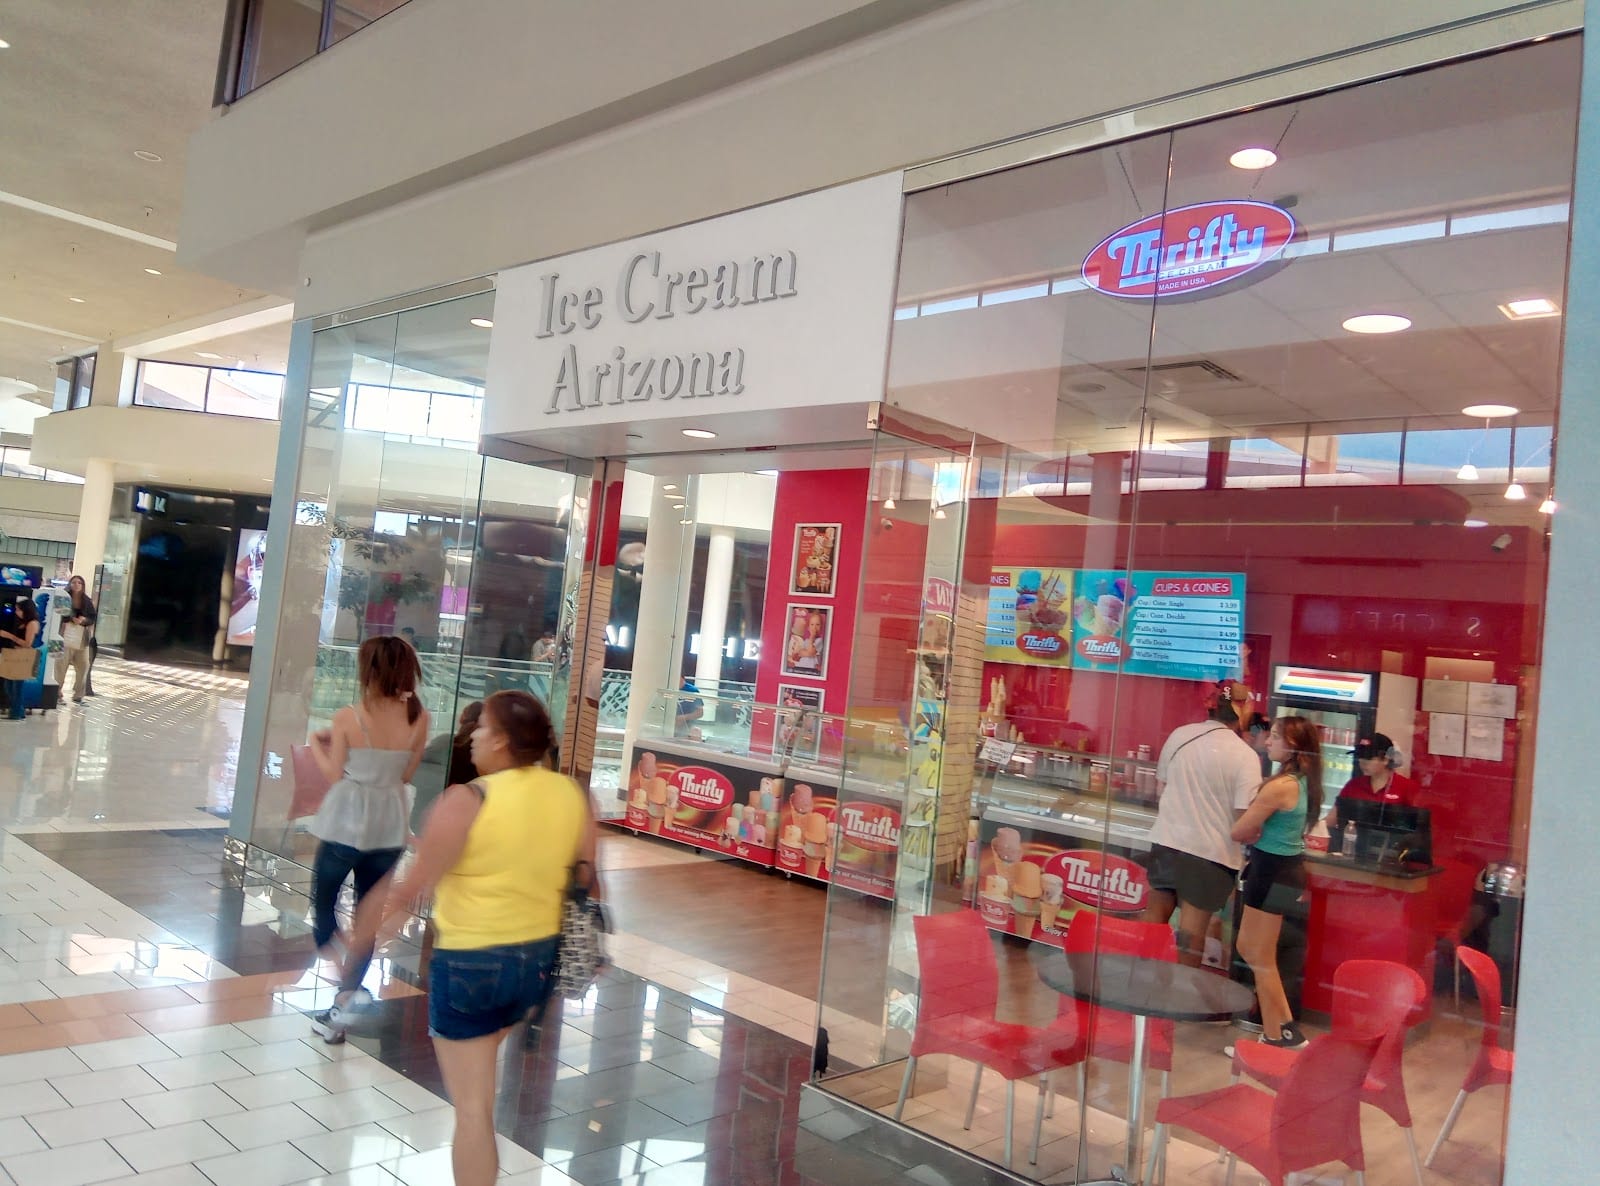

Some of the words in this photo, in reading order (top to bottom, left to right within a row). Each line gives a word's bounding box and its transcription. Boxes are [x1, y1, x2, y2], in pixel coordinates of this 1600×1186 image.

[1106, 213, 1265, 281] Thrifty
[1158, 281, 1180, 291] MADE
[1180, 279, 1189, 287] IN
[1190, 276, 1206, 285] USA
[1179, 260, 1225, 276] CREAM
[535, 271, 604, 339] Ice
[619, 249, 798, 323] Cream
[543, 342, 745, 414] Arizona
[990, 575, 1010, 585] NES
[1155, 583, 1180, 592] CUPS
[1182, 583, 1190, 592] &
[1192, 582, 1230, 593] CONES
[1023, 635, 1060, 651] Thrifty
[678, 771, 725, 804] Thrifty
[842, 808, 901, 847] Thrifty
[1061, 857, 1143, 904] Thrifty
